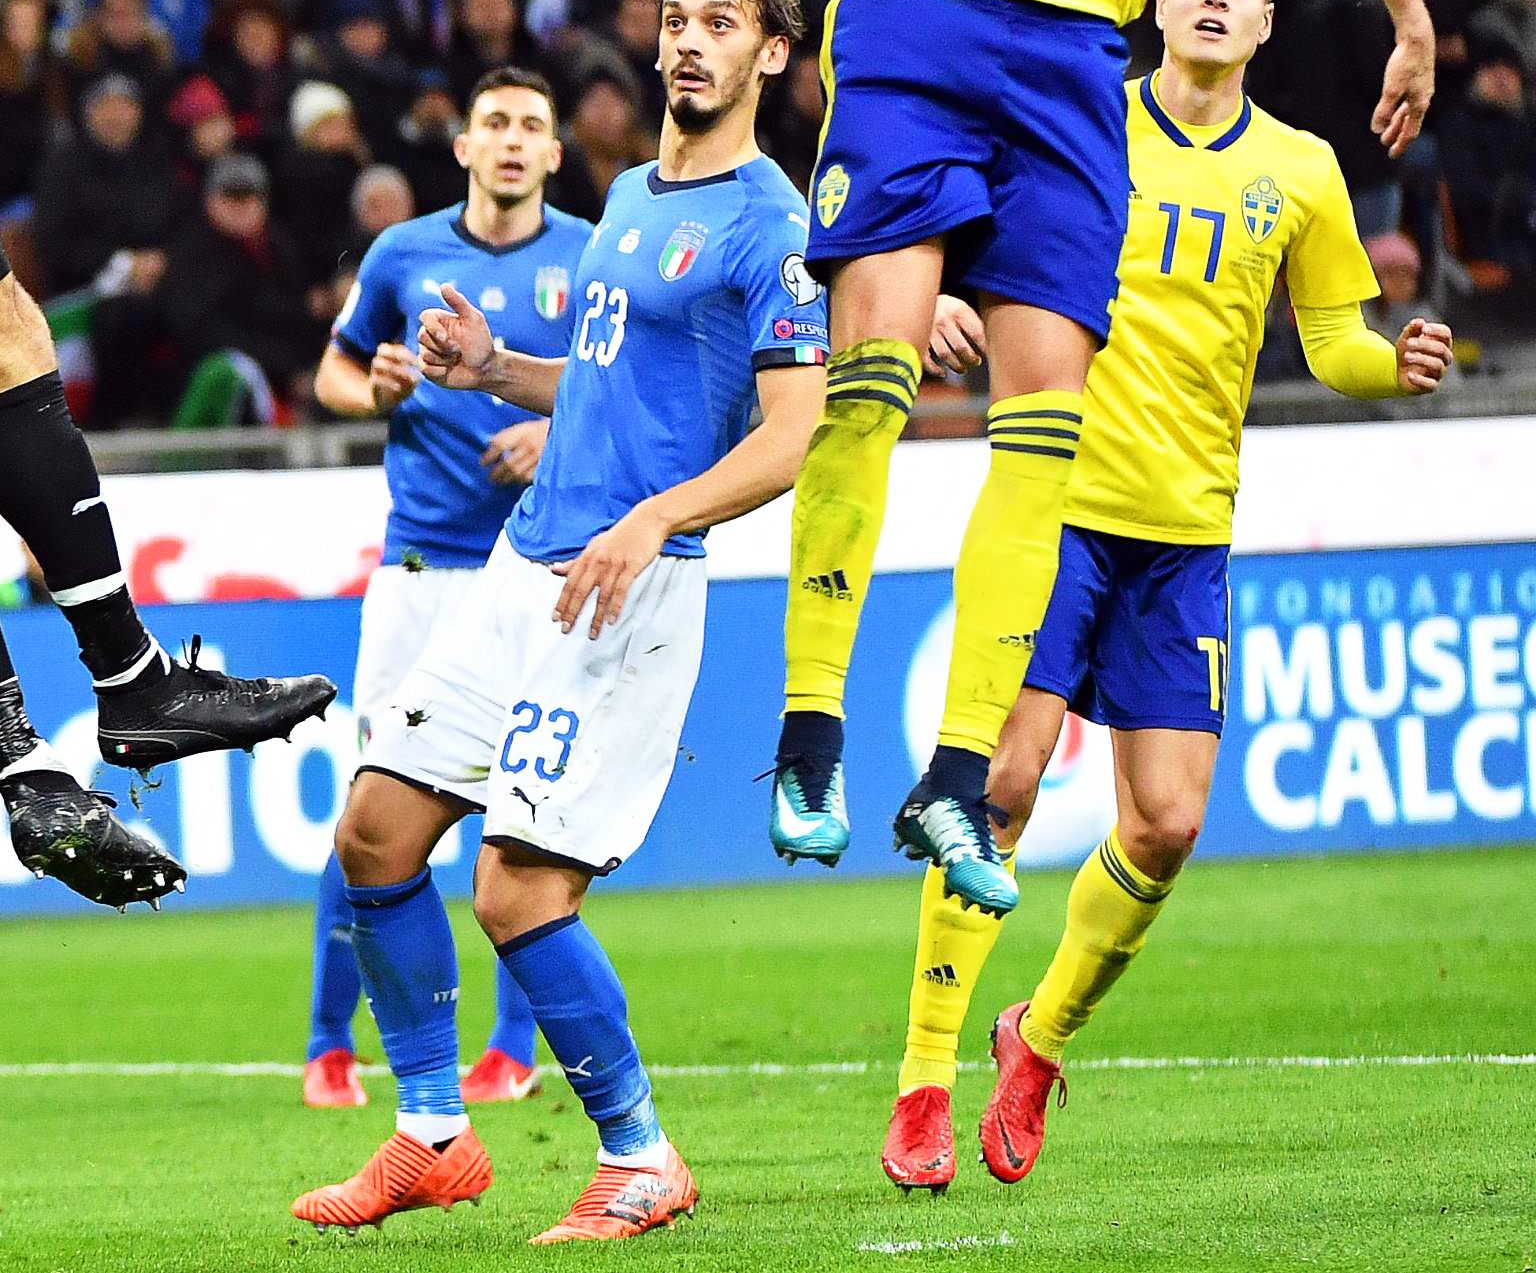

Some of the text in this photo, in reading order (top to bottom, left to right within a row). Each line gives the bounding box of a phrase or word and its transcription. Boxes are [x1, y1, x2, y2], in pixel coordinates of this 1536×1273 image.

[1158, 201, 1226, 283] 17
[577, 280, 629, 368] 23
[1242, 612, 1536, 723] MUSE
[500, 699, 580, 783] 23
